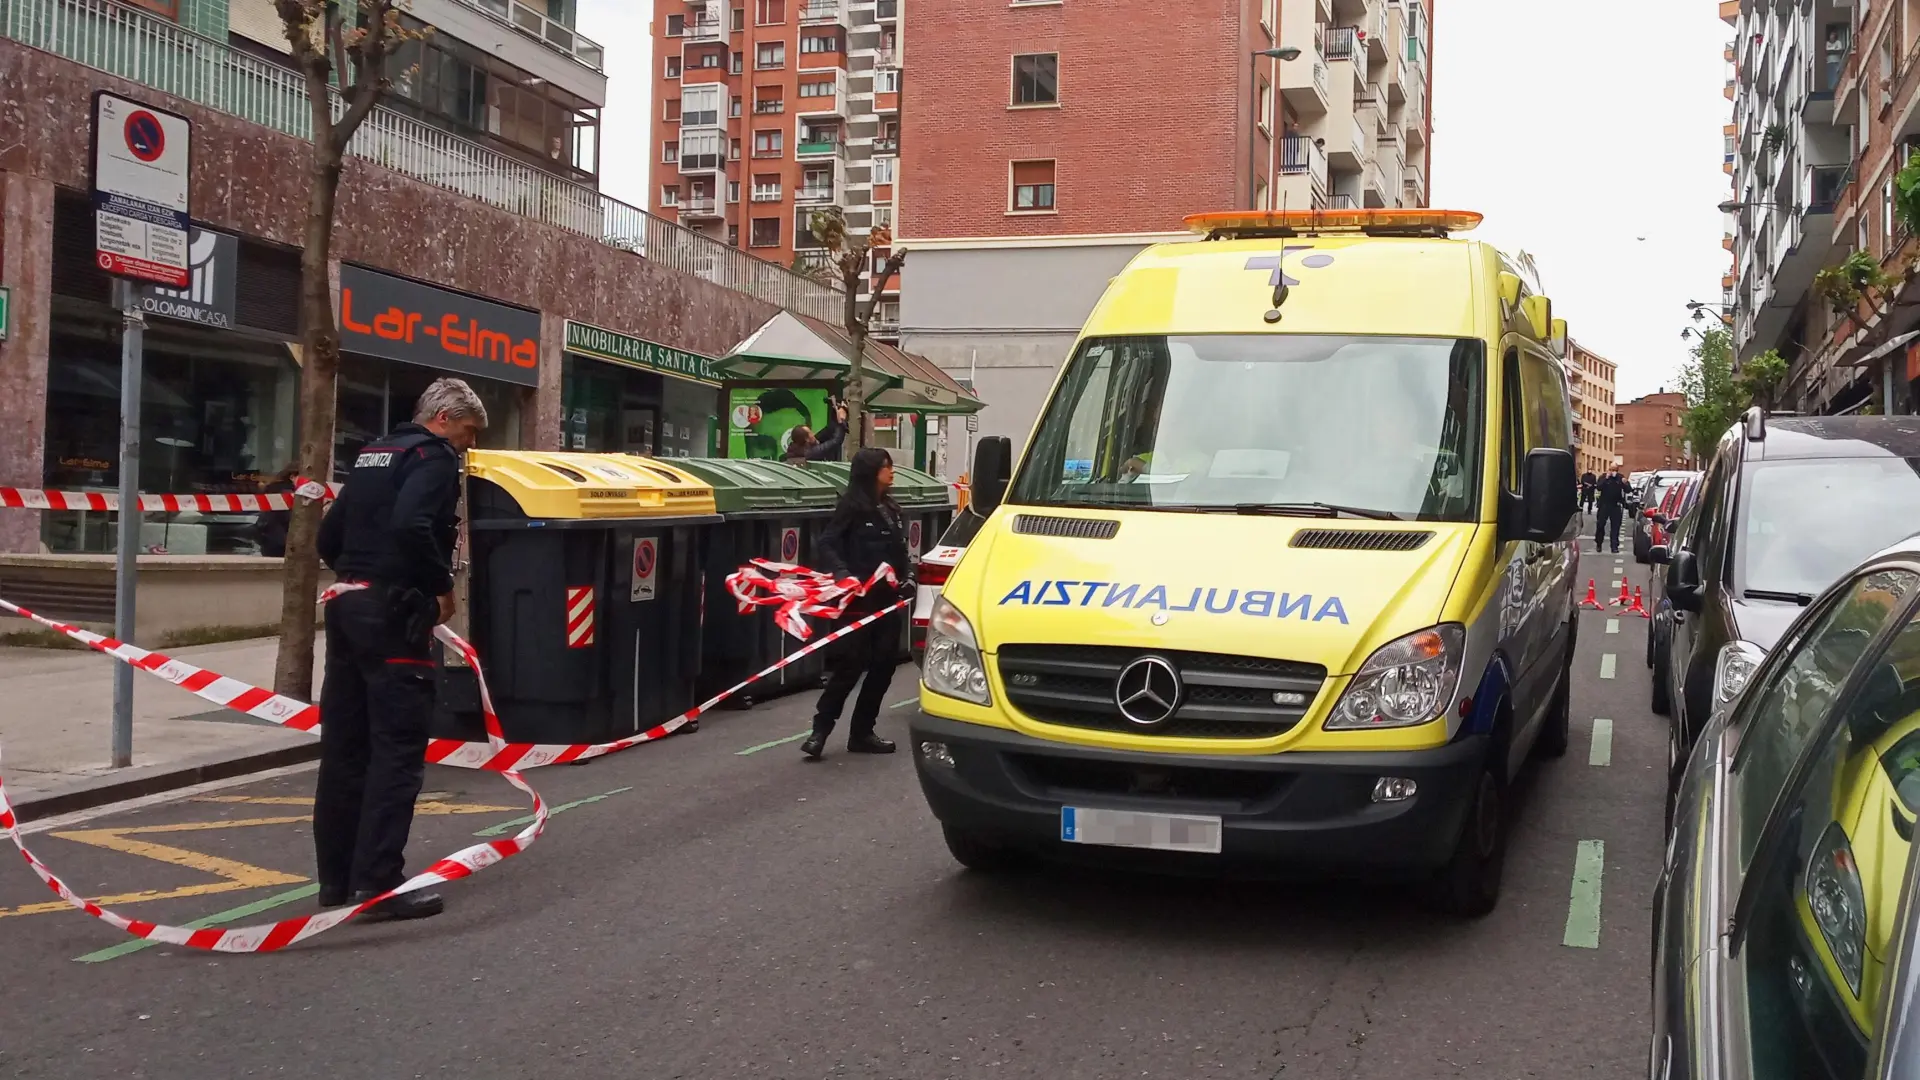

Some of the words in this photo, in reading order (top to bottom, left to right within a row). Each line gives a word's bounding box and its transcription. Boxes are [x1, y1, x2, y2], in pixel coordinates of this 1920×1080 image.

[101, 202, 128, 216] EXCEPTO
[128, 209, 148, 221] CARGA
[153, 216, 183, 229] DESCARGA
[342, 288, 537, 369] Lar-Elma
[567, 323, 653, 363] INMOBILIARIA
[657, 347, 696, 374] SANTA
